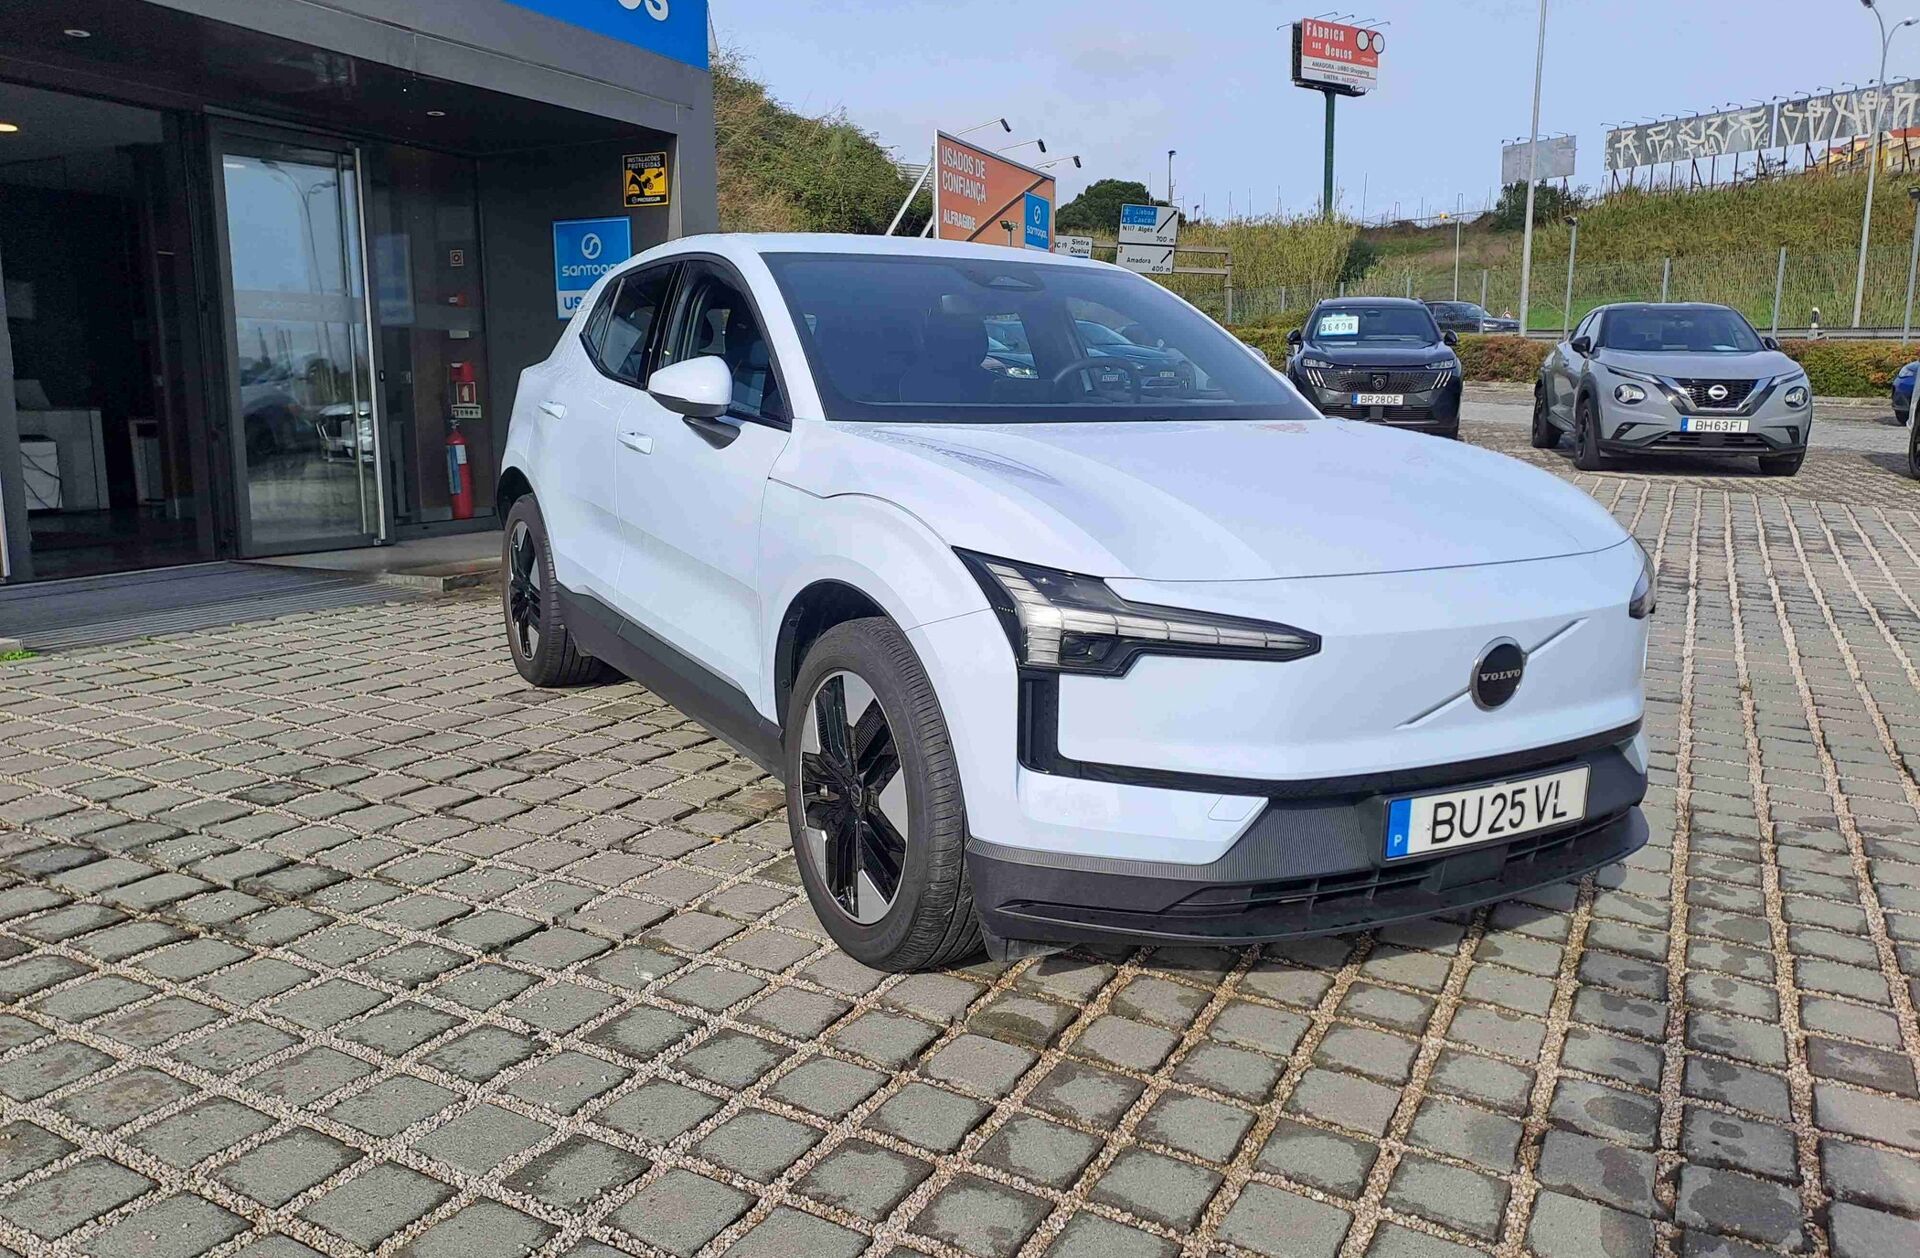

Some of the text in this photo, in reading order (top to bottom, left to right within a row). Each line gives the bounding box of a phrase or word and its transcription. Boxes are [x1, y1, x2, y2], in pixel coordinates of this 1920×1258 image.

[942, 145, 986, 179] USADOS DE
[942, 170, 987, 206] CONFIANÇA
[1136, 207, 1154, 215] Lisboa
[943, 209, 976, 231] ALFRAGIDE
[1071, 239, 1090, 247] Sintra
[1069, 246, 1090, 254] Queluz
[1479, 668, 1521, 682] VOLVO
[1394, 834, 1403, 847] P
